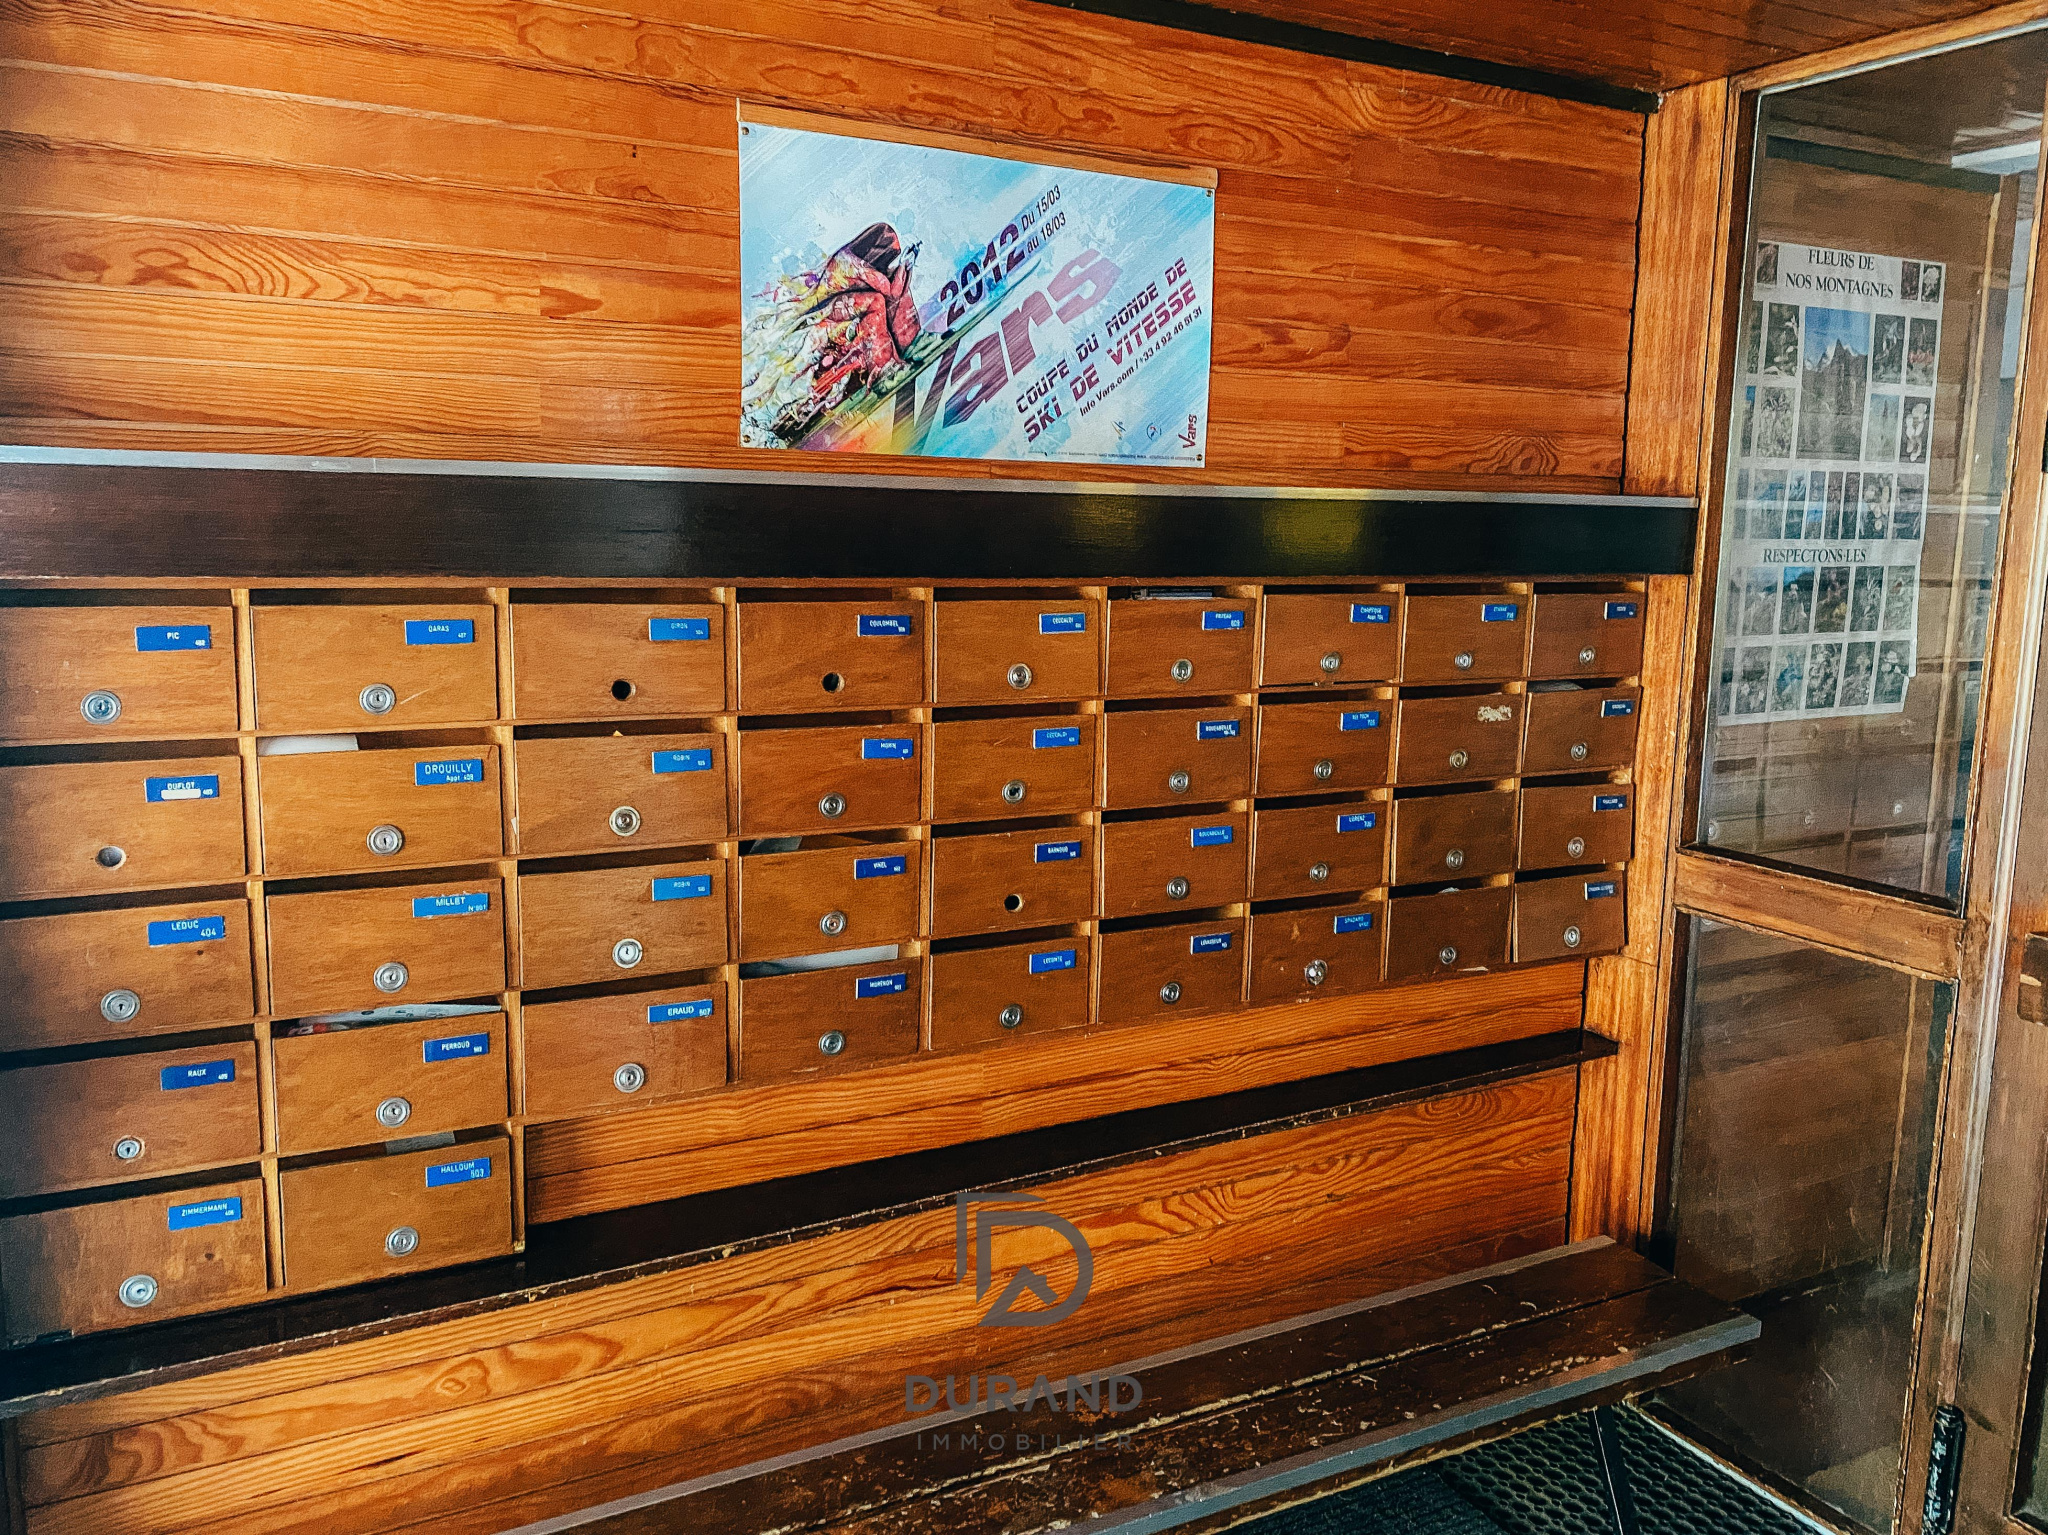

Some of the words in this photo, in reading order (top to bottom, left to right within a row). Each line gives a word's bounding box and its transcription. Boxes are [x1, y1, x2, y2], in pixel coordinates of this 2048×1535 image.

[1021, 211, 1035, 232] Du
[1036, 184, 1061, 217] 15/03
[1026, 236, 1039, 253] au
[1041, 211, 1066, 241] 18/03
[1808, 248, 1855, 269] FLEURS
[1858, 254, 1875, 271] DE
[940, 223, 1025, 327] 2012
[1785, 272, 1812, 289] NOS
[1816, 275, 1894, 298] MONTAGNES
[1015, 358, 1070, 414] COUPE
[1075, 333, 1099, 362] DU
[1105, 281, 1159, 338] MONDE
[1164, 256, 1188, 287] DE
[891, 249, 1123, 454] Vars
[1023, 395, 1063, 442] SKI
[1069, 362, 1100, 402] DE
[1106, 278, 1197, 367] VITESSE
[1080, 400, 1096, 417] Info
[1177, 414, 1198, 449] Vars
[167, 631, 180, 640] PIC
[424, 763, 472, 776] DROUILLY
[436, 896, 466, 907] MILLET
[171, 919, 200, 931] LEDUC
[187, 1067, 207, 1077] RAUX
[440, 1161, 475, 1174] HALLOUM
[181, 1202, 229, 1217] ZIMMERMANN
